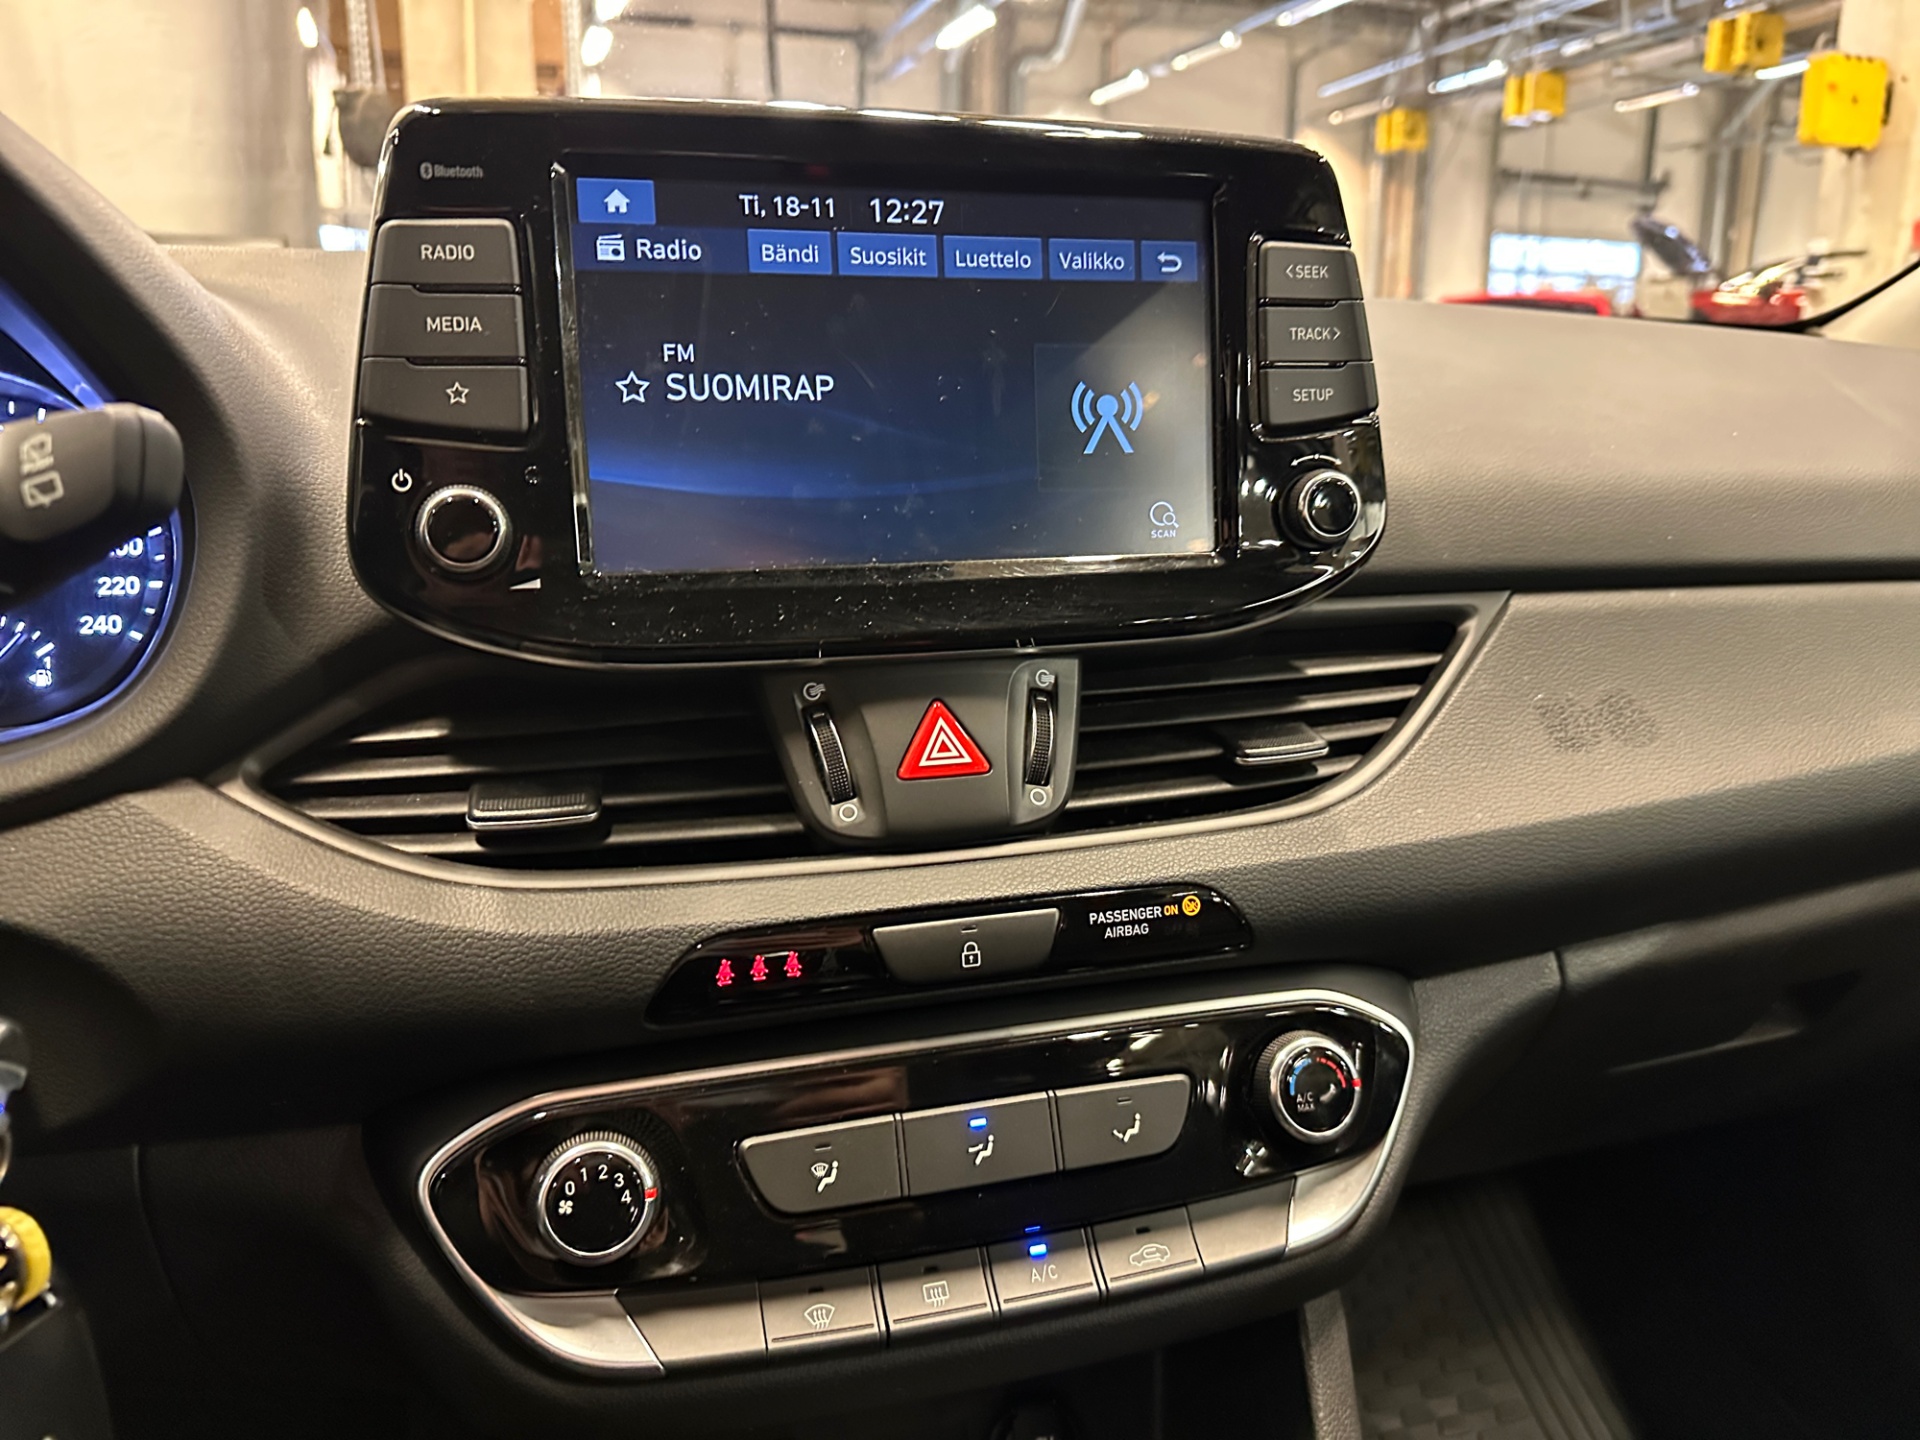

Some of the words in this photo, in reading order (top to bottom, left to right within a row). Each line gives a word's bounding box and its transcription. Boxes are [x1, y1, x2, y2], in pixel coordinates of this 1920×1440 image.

[434, 163, 484, 179] Bluetooth
[738, 194, 766, 218] Ti,
[773, 195, 836, 219] 18-11
[869, 198, 945, 225] 12:27
[420, 243, 475, 262] RADIO
[635, 238, 702, 262] Radio
[761, 242, 820, 264] Bändi
[849, 245, 927, 268] Suosikit
[954, 248, 1032, 269] Luettelo
[1058, 250, 1125, 272] Valikko
[1295, 264, 1329, 280] SEEK
[425, 315, 483, 333] MEDIA
[1289, 325, 1331, 342] TRACK
[662, 343, 695, 363] FM
[666, 373, 834, 401] SUOMIRAP
[1292, 387, 1334, 403] SETUP
[1151, 529, 1176, 539] SCAN
[97, 575, 140, 597] 220
[79, 614, 122, 635] 240
[1089, 906, 1162, 925] PASSENGER
[1164, 904, 1179, 916] ON
[1104, 923, 1150, 939] AIRBAG
[1296, 1091, 1314, 1103] A/C
[1297, 1103, 1315, 1112] MAX
[565, 1181, 575, 1196] 0
[580, 1167, 587, 1182] 1
[598, 1164, 609, 1180] 2
[614, 1173, 624, 1188] 3
[621, 1189, 632, 1204] 4
[1031, 1263, 1058, 1284] A/C
